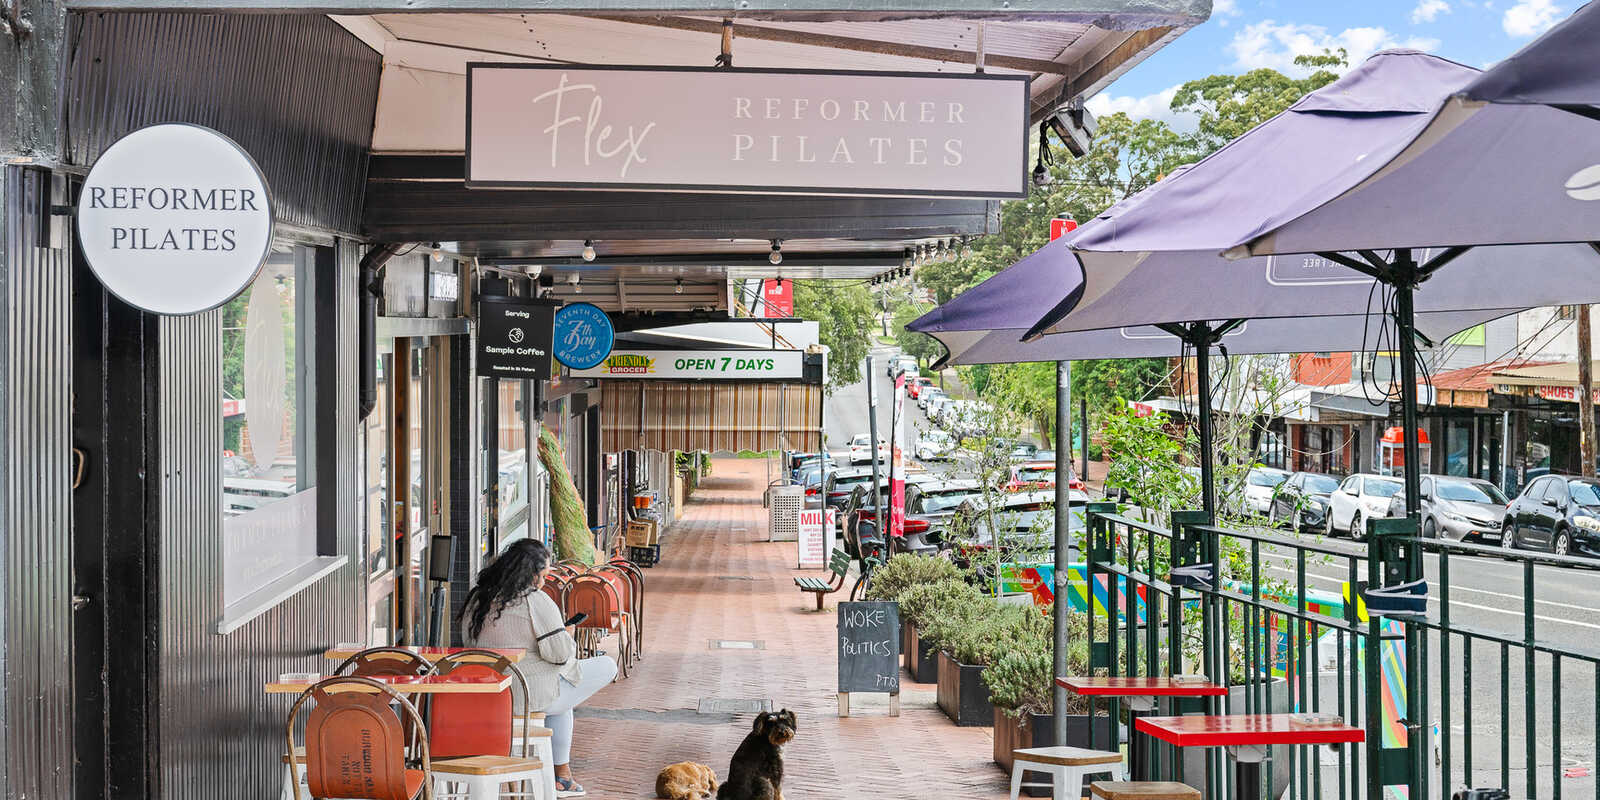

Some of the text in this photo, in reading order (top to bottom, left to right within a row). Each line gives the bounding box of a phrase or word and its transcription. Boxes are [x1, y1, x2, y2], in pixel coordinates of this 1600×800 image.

[735, 97, 968, 124] REFORMER
[532, 73, 656, 179] Flex
[732, 134, 964, 167] PILATES
[89, 186, 259, 212] REFORMER
[111, 227, 237, 252] PILATES
[505, 310, 530, 319] Serving
[485, 345, 545, 357] Sample Coffee
[559, 349, 602, 364] BREWERY
[610, 354, 648, 367] FRIENDLY
[674, 357, 774, 372] OPEN 7 DAYS
[610, 366, 647, 374] GROCER
[1540, 384, 1575, 399] SHOES
[800, 512, 834, 526] MILK
[843, 607, 885, 628] WOKE
[841, 635, 892, 658] POLITICS
